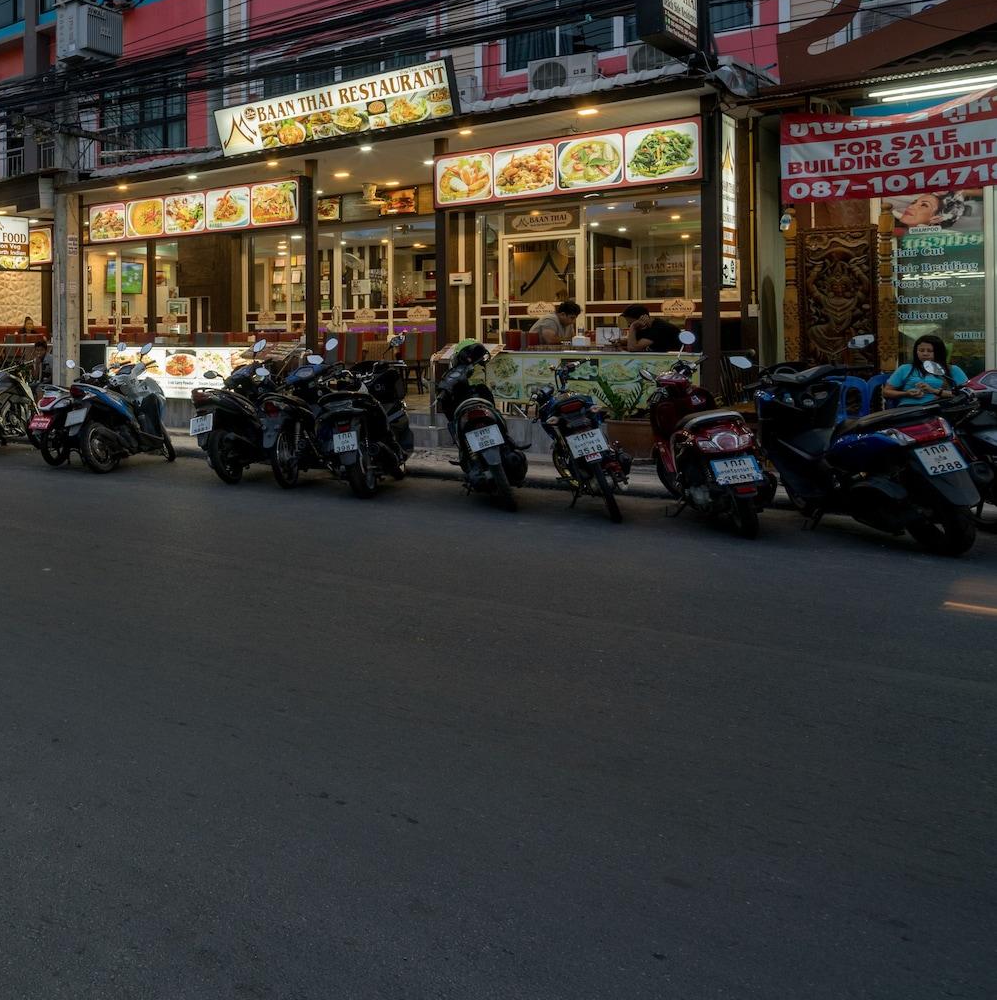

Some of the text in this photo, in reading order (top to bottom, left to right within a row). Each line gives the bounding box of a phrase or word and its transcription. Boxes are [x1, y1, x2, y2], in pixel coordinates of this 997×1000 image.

[257, 98, 296, 122] BAAN
[297, 91, 332, 113] THAI
[338, 66, 445, 105] RESTAURANT
[834, 128, 958, 158] FOR SALE
[788, 138, 996, 176] BUILDING 2 UNIT
[2, 232, 27, 243] FOOD
[921, 246, 945, 256] Cut
[893, 261, 979, 273] Hair Braiding
[922, 279, 947, 291] Spa
[578, 443, 603, 457] 3518
[930, 460, 963, 474] 2288
